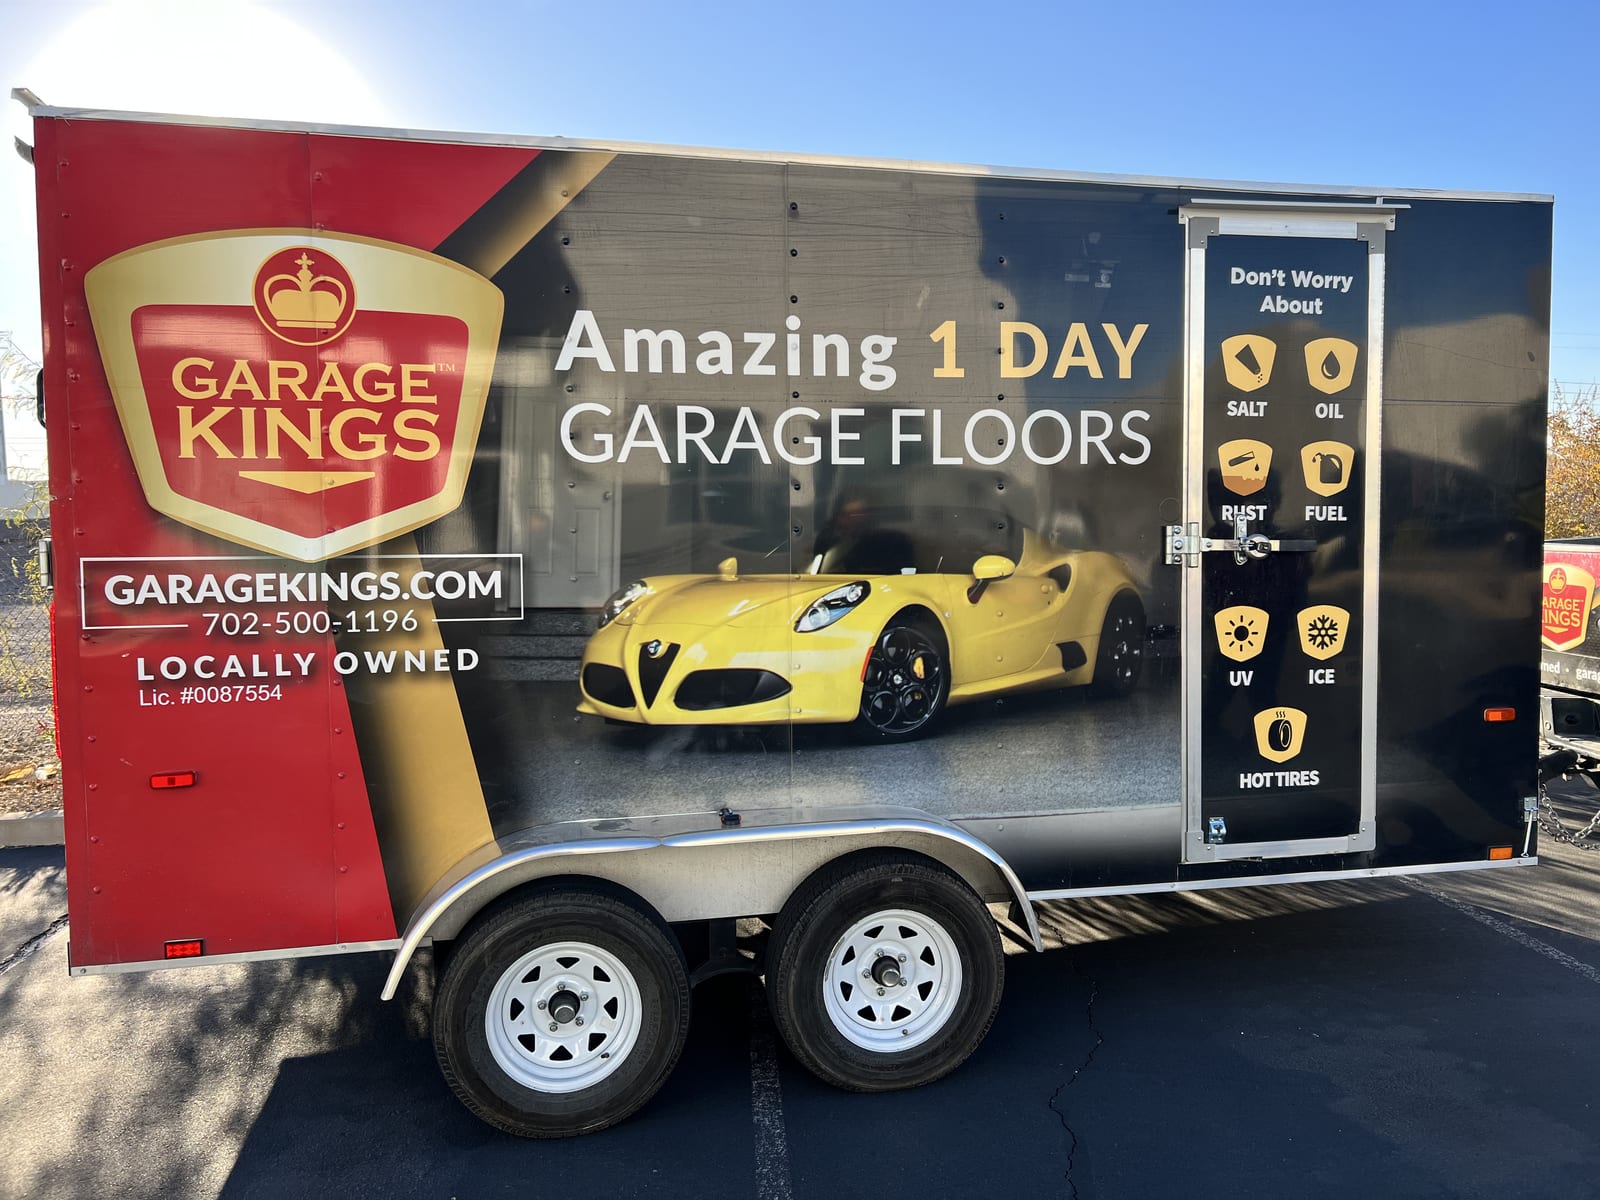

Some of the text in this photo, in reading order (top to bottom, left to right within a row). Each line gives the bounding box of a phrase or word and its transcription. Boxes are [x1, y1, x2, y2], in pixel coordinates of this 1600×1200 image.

[1231, 267, 1354, 293] Don't Worry
[1259, 295, 1323, 315] About
[555, 310, 1149, 391] Amazing 1 DAY
[172, 357, 437, 404] GARAGE
[1227, 401, 1268, 417] SALT
[1315, 403, 1344, 419] OIL
[177, 405, 441, 461] KINGS
[560, 402, 1152, 466] GARAGE FLOORS
[1222, 505, 1268, 521] RUST
[1305, 506, 1347, 521] FUEL
[104, 570, 502, 605] GARAGEKINGS.COM
[1542, 597, 1580, 611] ARAGE
[202, 609, 418, 636] 702-500-1196
[1542, 609, 1581, 627] INGS
[137, 648, 480, 681] LOCALLY OWNED
[1229, 671, 1254, 686] UV
[1308, 669, 1335, 685] ICE
[139, 684, 283, 707] Lic. #0087554
[1239, 770, 1320, 789] HOT TIRES
